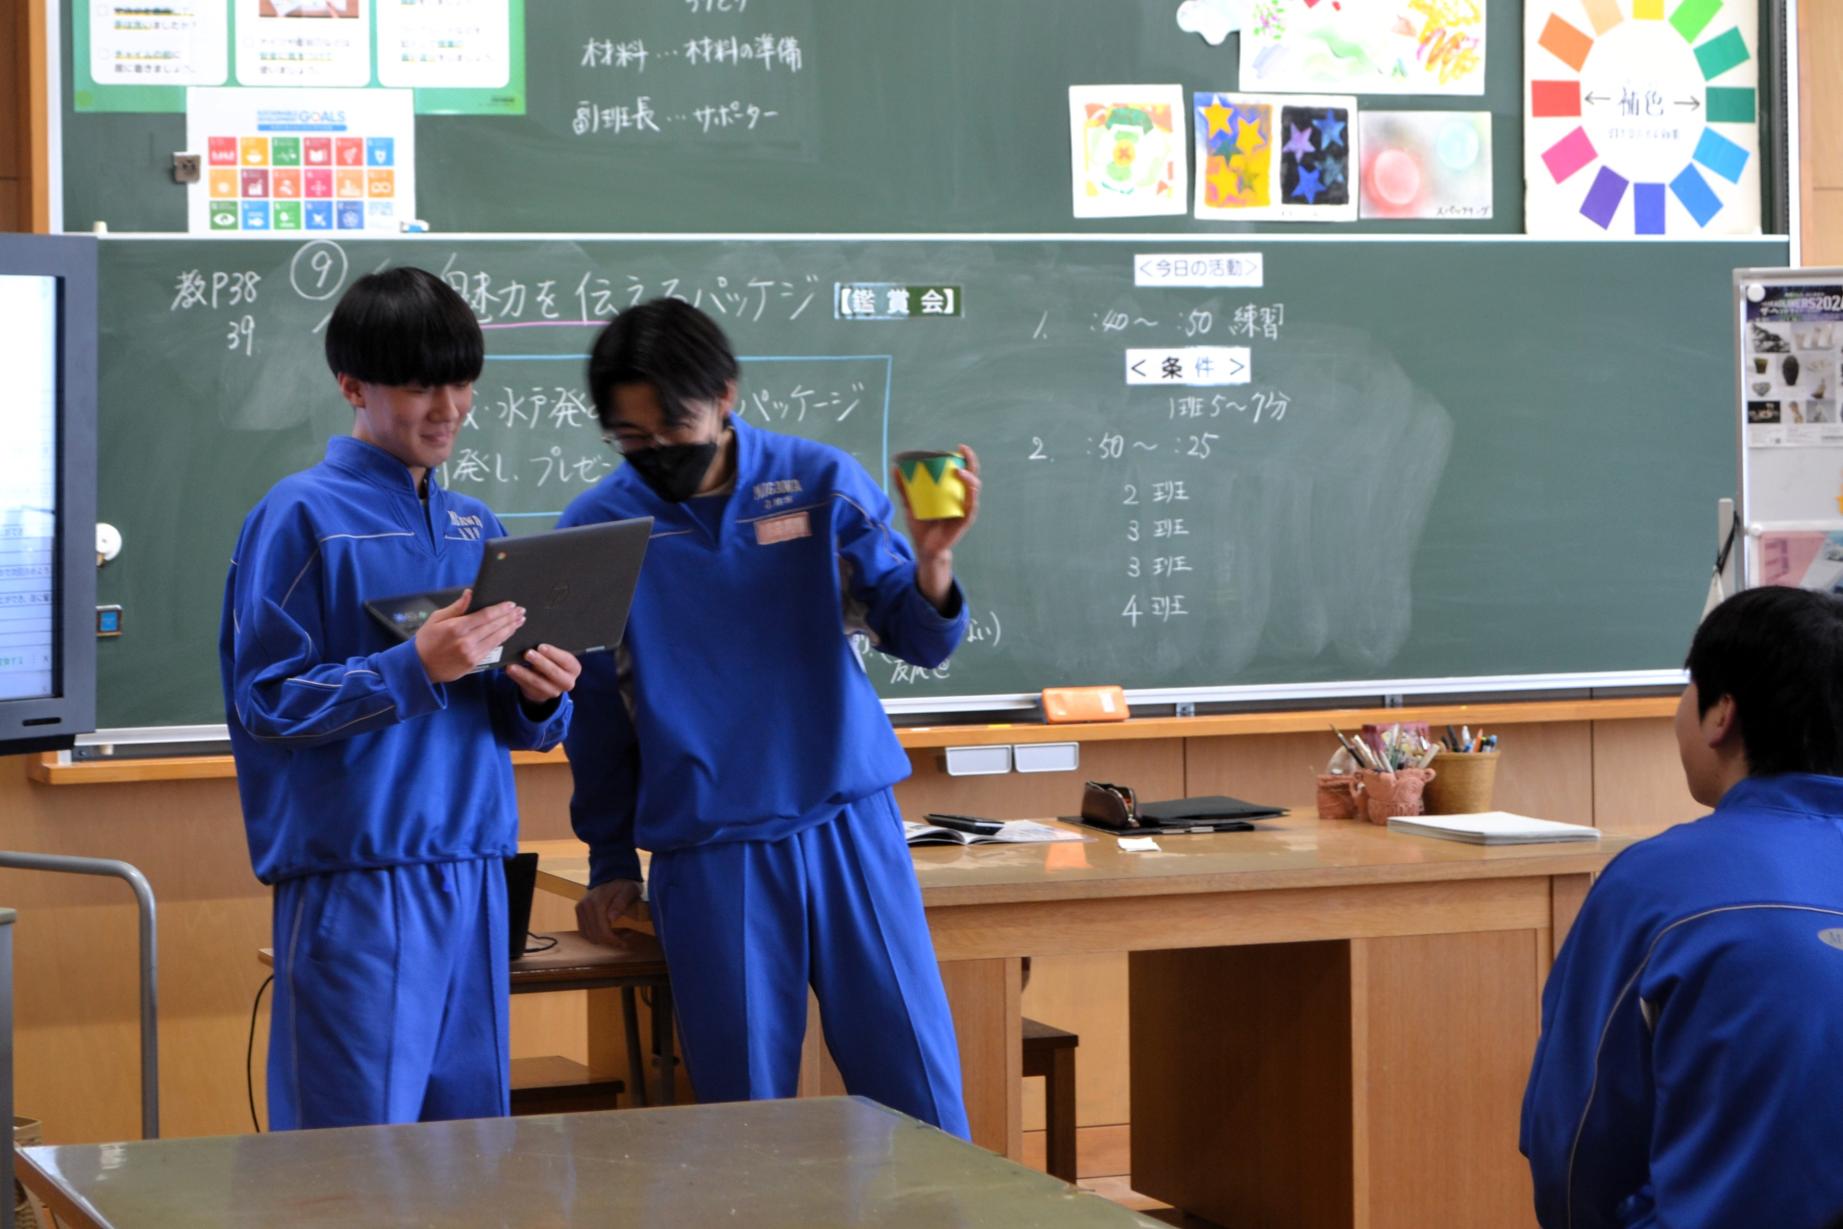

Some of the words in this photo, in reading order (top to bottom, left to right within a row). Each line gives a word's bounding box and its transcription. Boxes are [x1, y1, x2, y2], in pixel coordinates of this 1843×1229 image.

[1618, 85, 1664, 117] 補色
[299, 110, 346, 122] GOALS
[841, 288, 955, 315] 【鑑賞会】
[226, 314, 256, 356] 39
